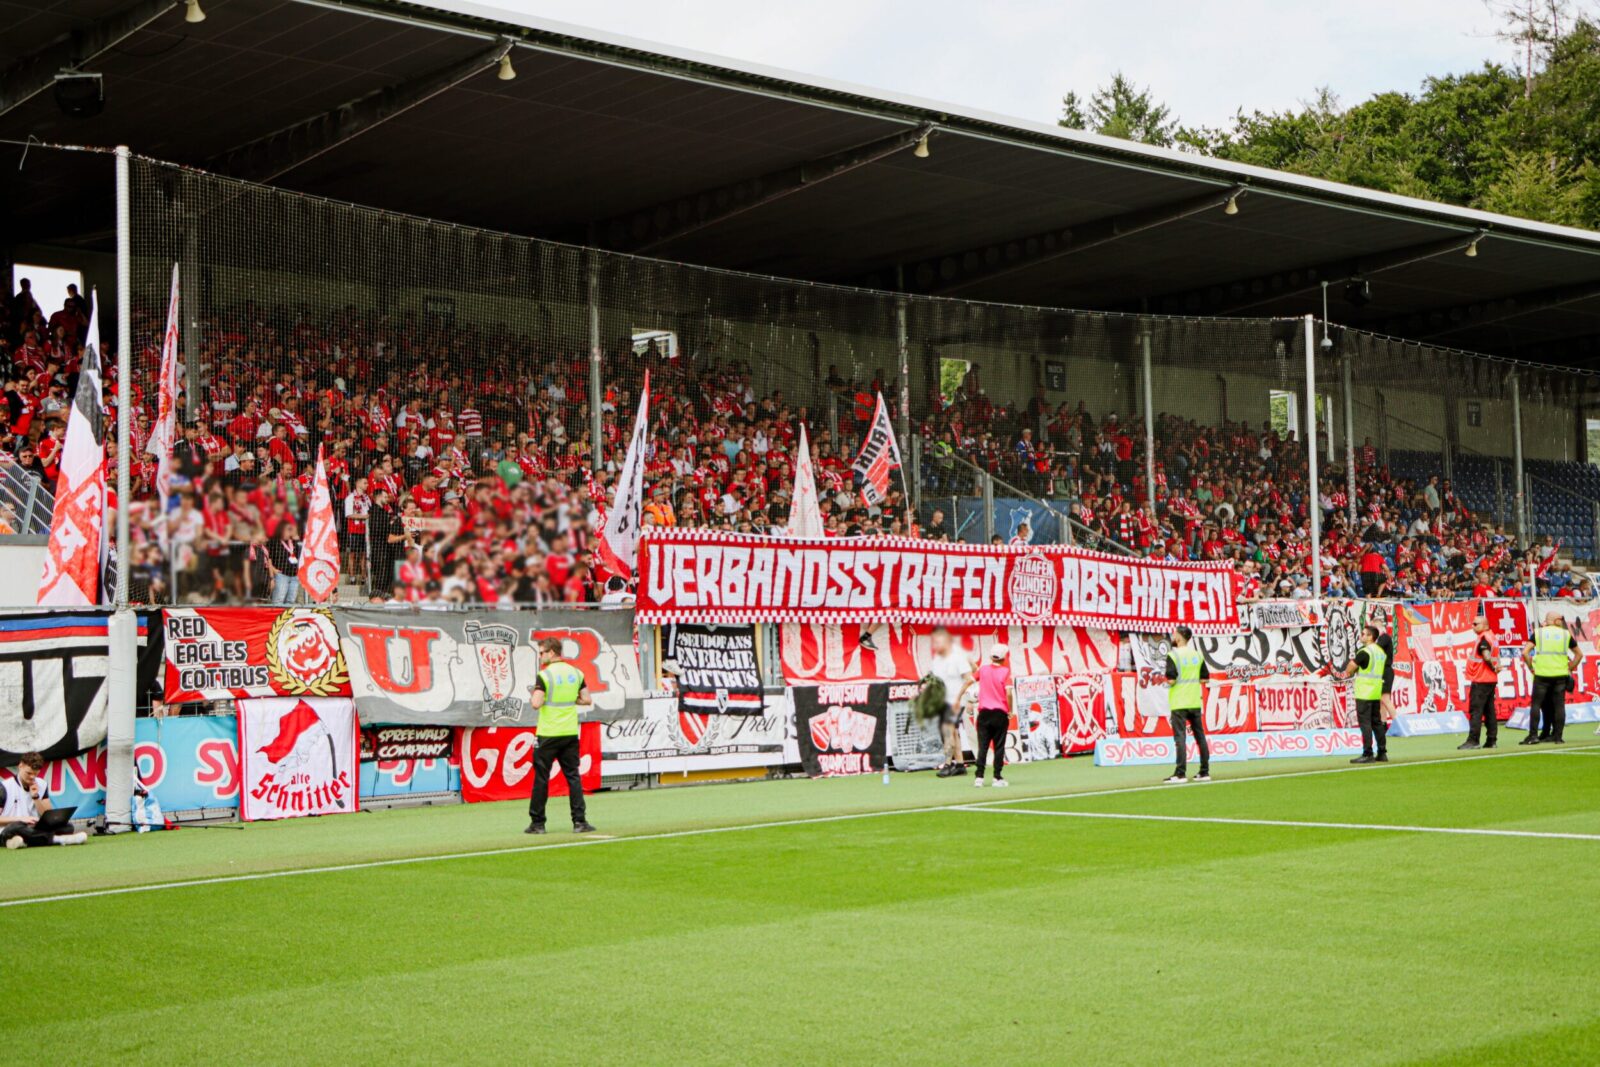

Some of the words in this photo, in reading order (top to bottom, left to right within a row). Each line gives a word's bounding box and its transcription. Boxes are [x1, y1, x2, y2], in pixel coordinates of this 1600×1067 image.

[1015, 557, 1054, 577] STRAFEN
[647, 544, 1007, 611] VERBANDSSTRAFEN
[1061, 556, 1233, 622] ABSCHAFFEN!
[168, 617, 206, 639] RED
[175, 642, 247, 664] EAGLES
[180, 667, 269, 691] COTTBUS
[1259, 686, 1319, 719] energie
[377, 727, 450, 743] SPREEWALD
[1248, 734, 1309, 757] syNeo
[1315, 731, 1364, 753] syNe
[377, 743, 448, 759] COMPANY
[1105, 740, 1169, 763] syNeo
[290, 772, 311, 785] alte
[250, 770, 351, 812] Schnitter
